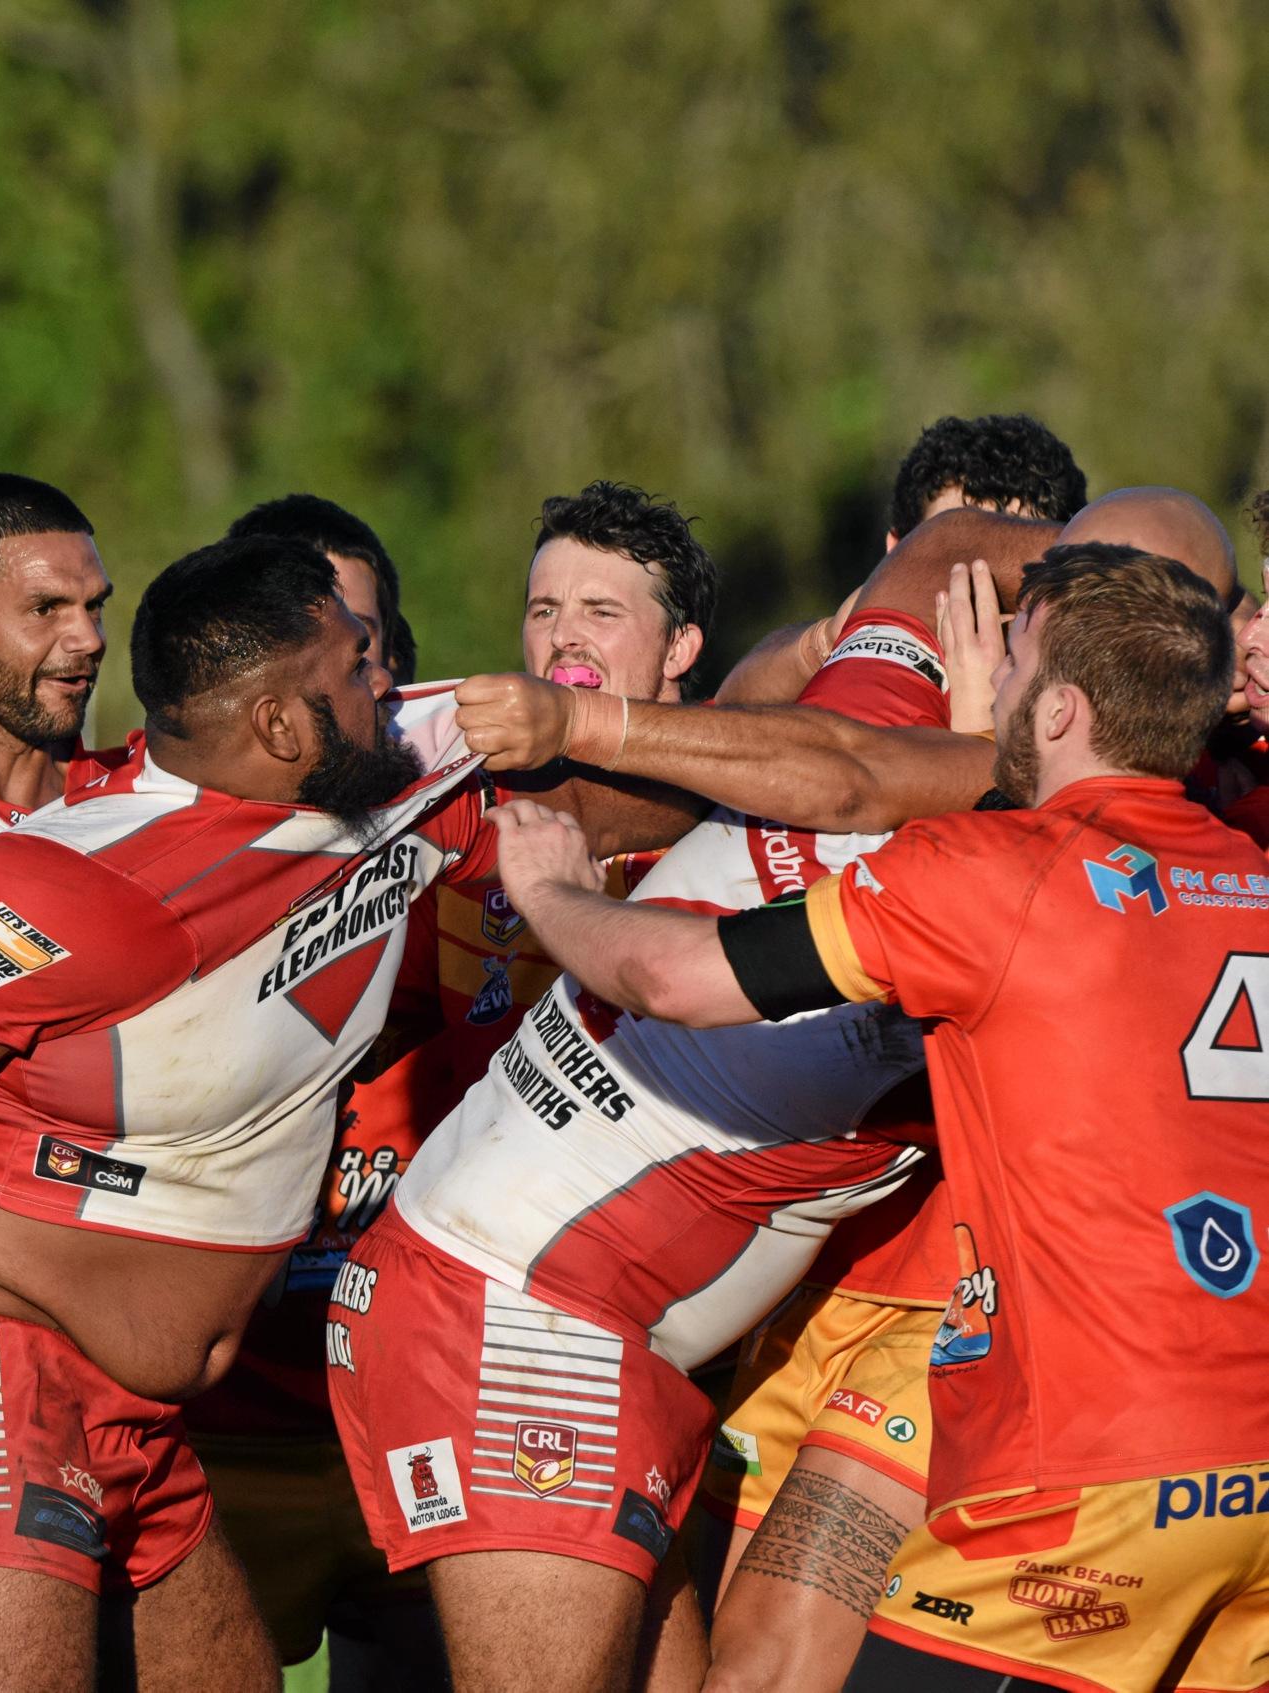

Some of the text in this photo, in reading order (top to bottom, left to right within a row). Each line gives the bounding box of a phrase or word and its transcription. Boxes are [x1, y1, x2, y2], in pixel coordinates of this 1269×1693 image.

[1169, 867, 1210, 892] FM
[23, 928, 64, 956] TACKLE
[535, 999, 636, 1122] BROTHERS
[53, 1146, 79, 1159] CRL
[95, 1171, 133, 1189] CSM
[522, 1429, 570, 1452] CRL
[410, 1506, 462, 1528] MOTOR LODGE
[1015, 1560, 1145, 1589] PARK BEACH
[911, 1591, 975, 1626] ZBR
[1013, 1579, 1095, 1611] HOME
[1048, 1609, 1124, 1636] BASE
